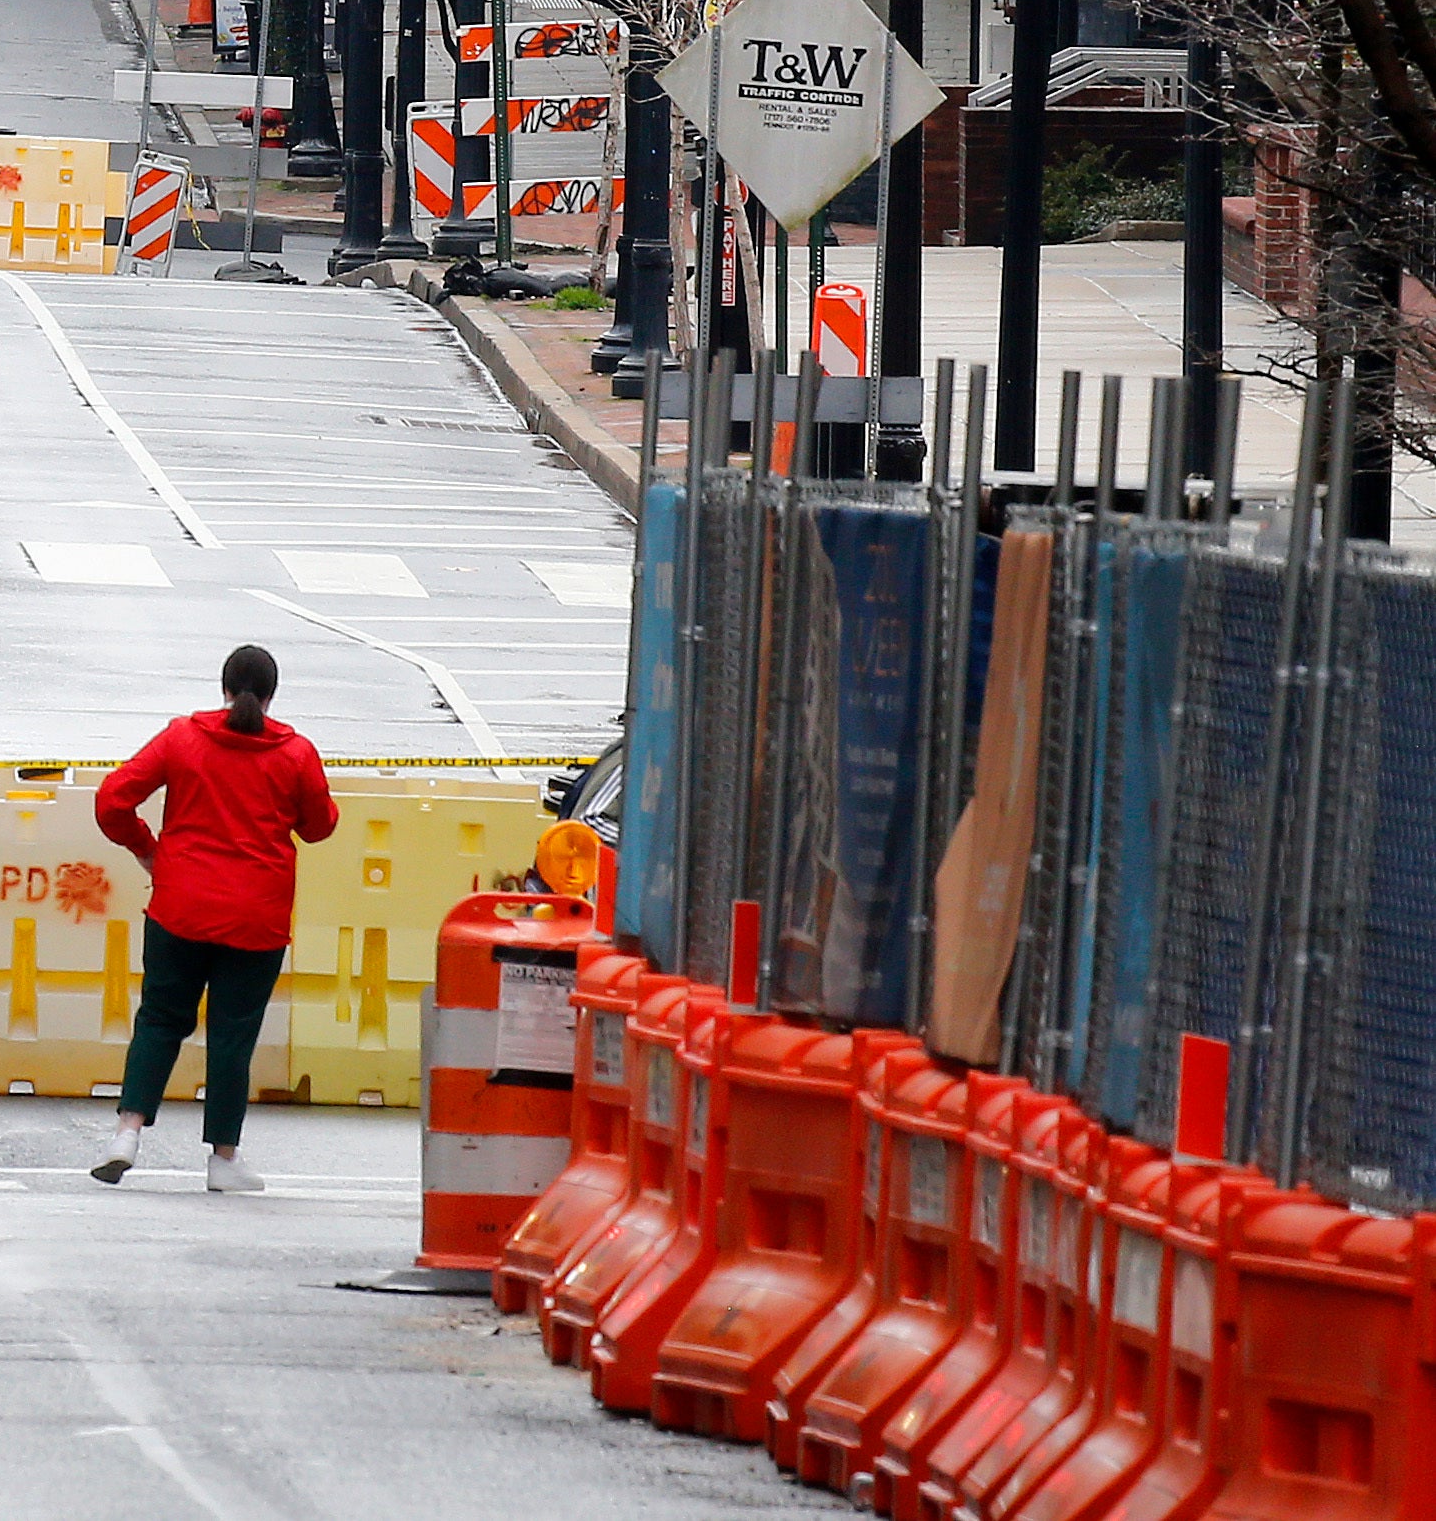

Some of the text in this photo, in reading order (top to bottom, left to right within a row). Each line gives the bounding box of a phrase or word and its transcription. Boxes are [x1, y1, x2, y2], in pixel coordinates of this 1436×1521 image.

[743, 39, 867, 89] T&W
[742, 86, 796, 99] TRAFFIC
[759, 103, 793, 113] RENTAL
[808, 107, 837, 117] SALES
[722, 220, 734, 302] PAY HERE
